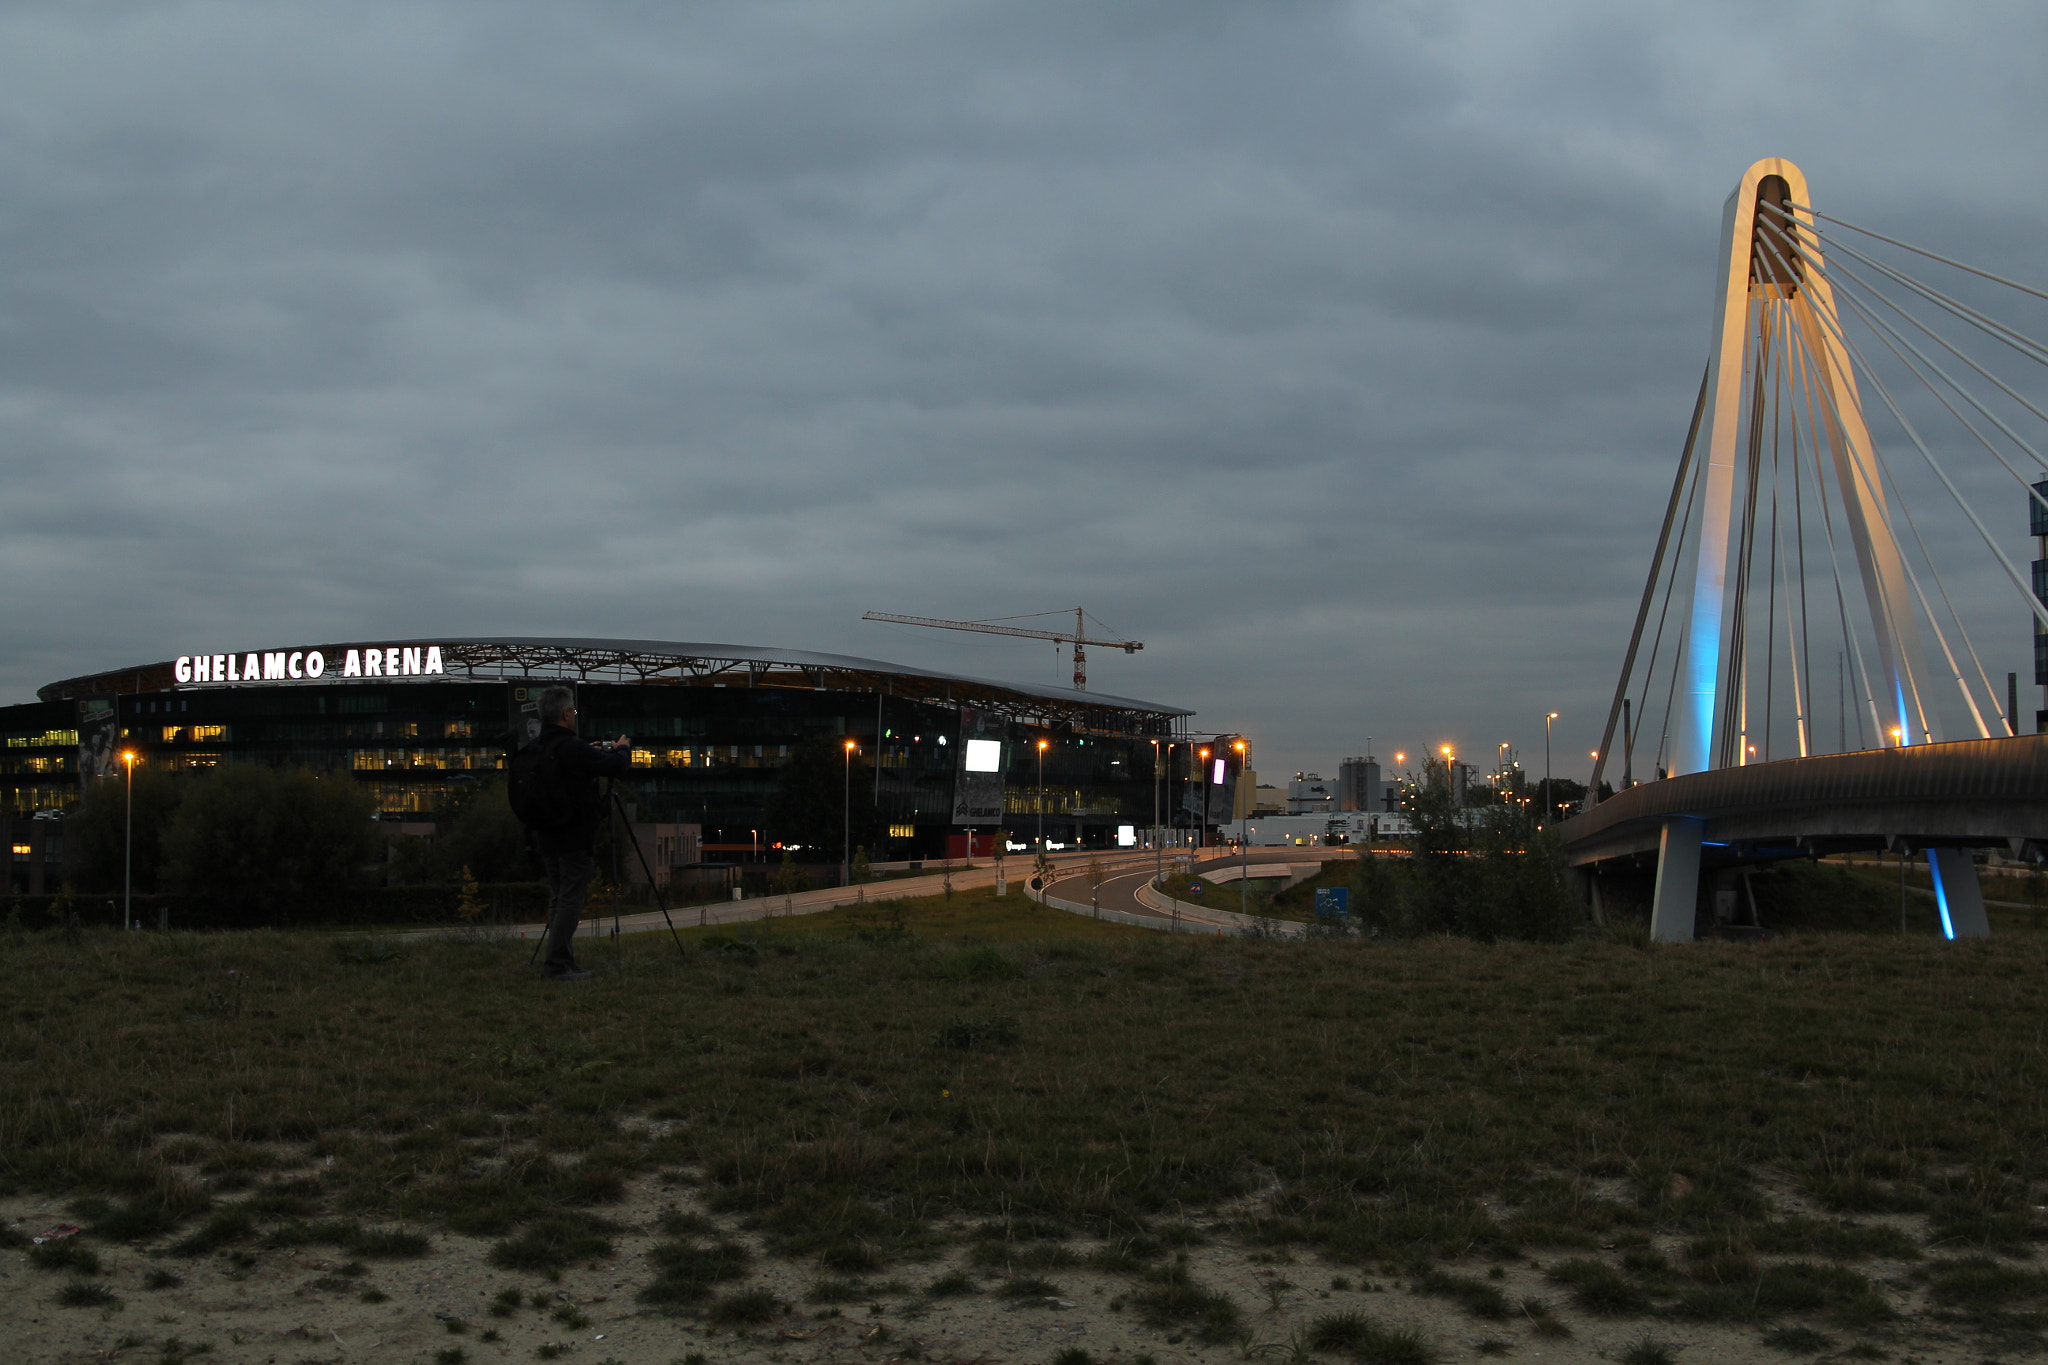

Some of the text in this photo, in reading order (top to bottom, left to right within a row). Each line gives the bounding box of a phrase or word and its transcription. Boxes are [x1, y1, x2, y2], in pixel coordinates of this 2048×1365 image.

[175, 646, 444, 683] GHELAMCO ARENA
[970, 807, 1001, 817] GHELAMCO
